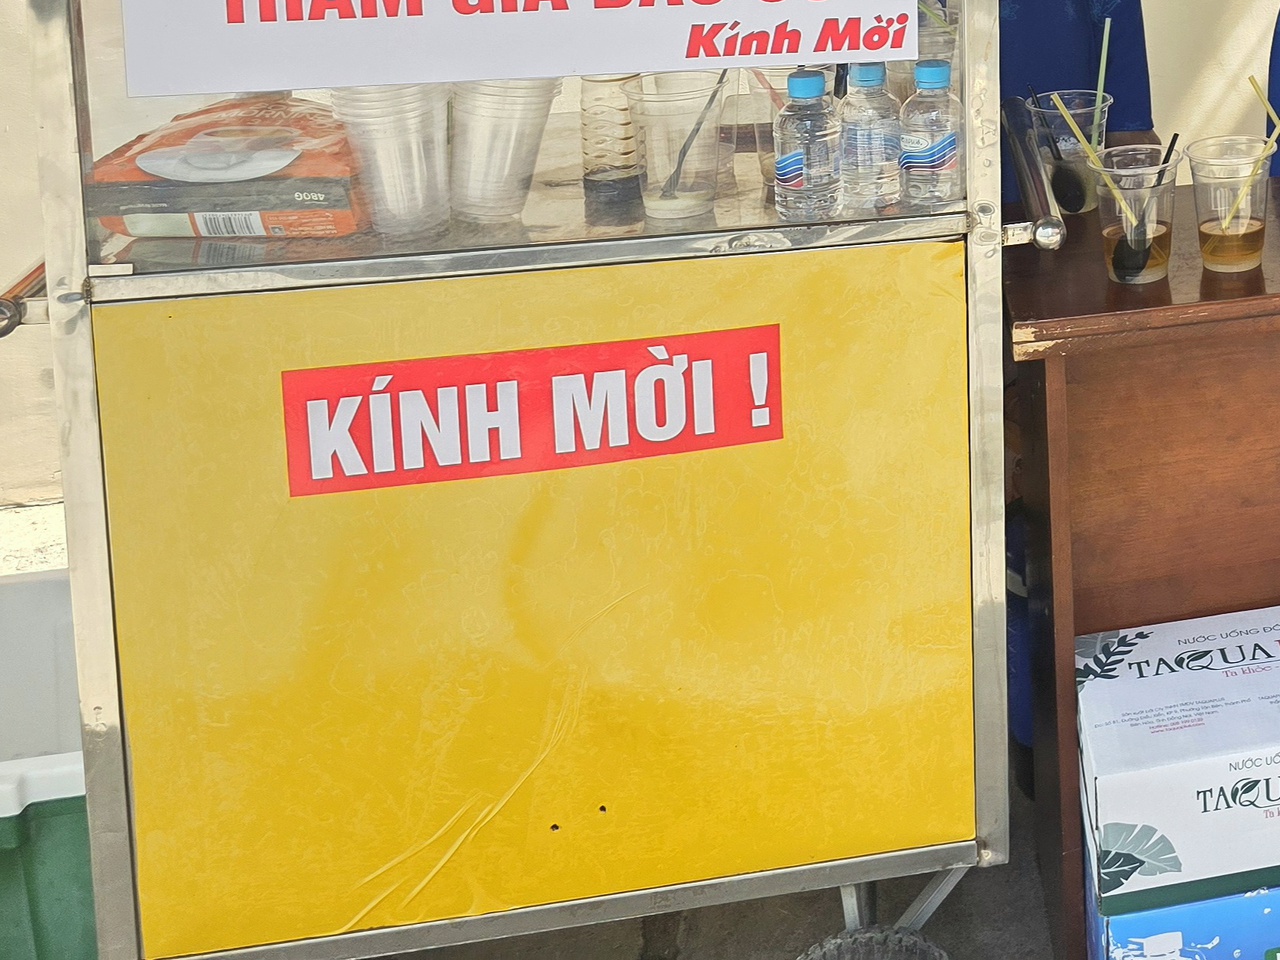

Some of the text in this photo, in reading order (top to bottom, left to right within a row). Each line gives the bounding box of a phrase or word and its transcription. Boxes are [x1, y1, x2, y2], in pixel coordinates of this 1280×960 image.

[684, 11, 910, 60] Kính Mời
[306, 344, 771, 480] KÍNH MỜI !
[1178, 633, 1217, 646] NƯỚC
[1220, 627, 1260, 639] UỐNG
[1229, 757, 1263, 772] NƯỚC
